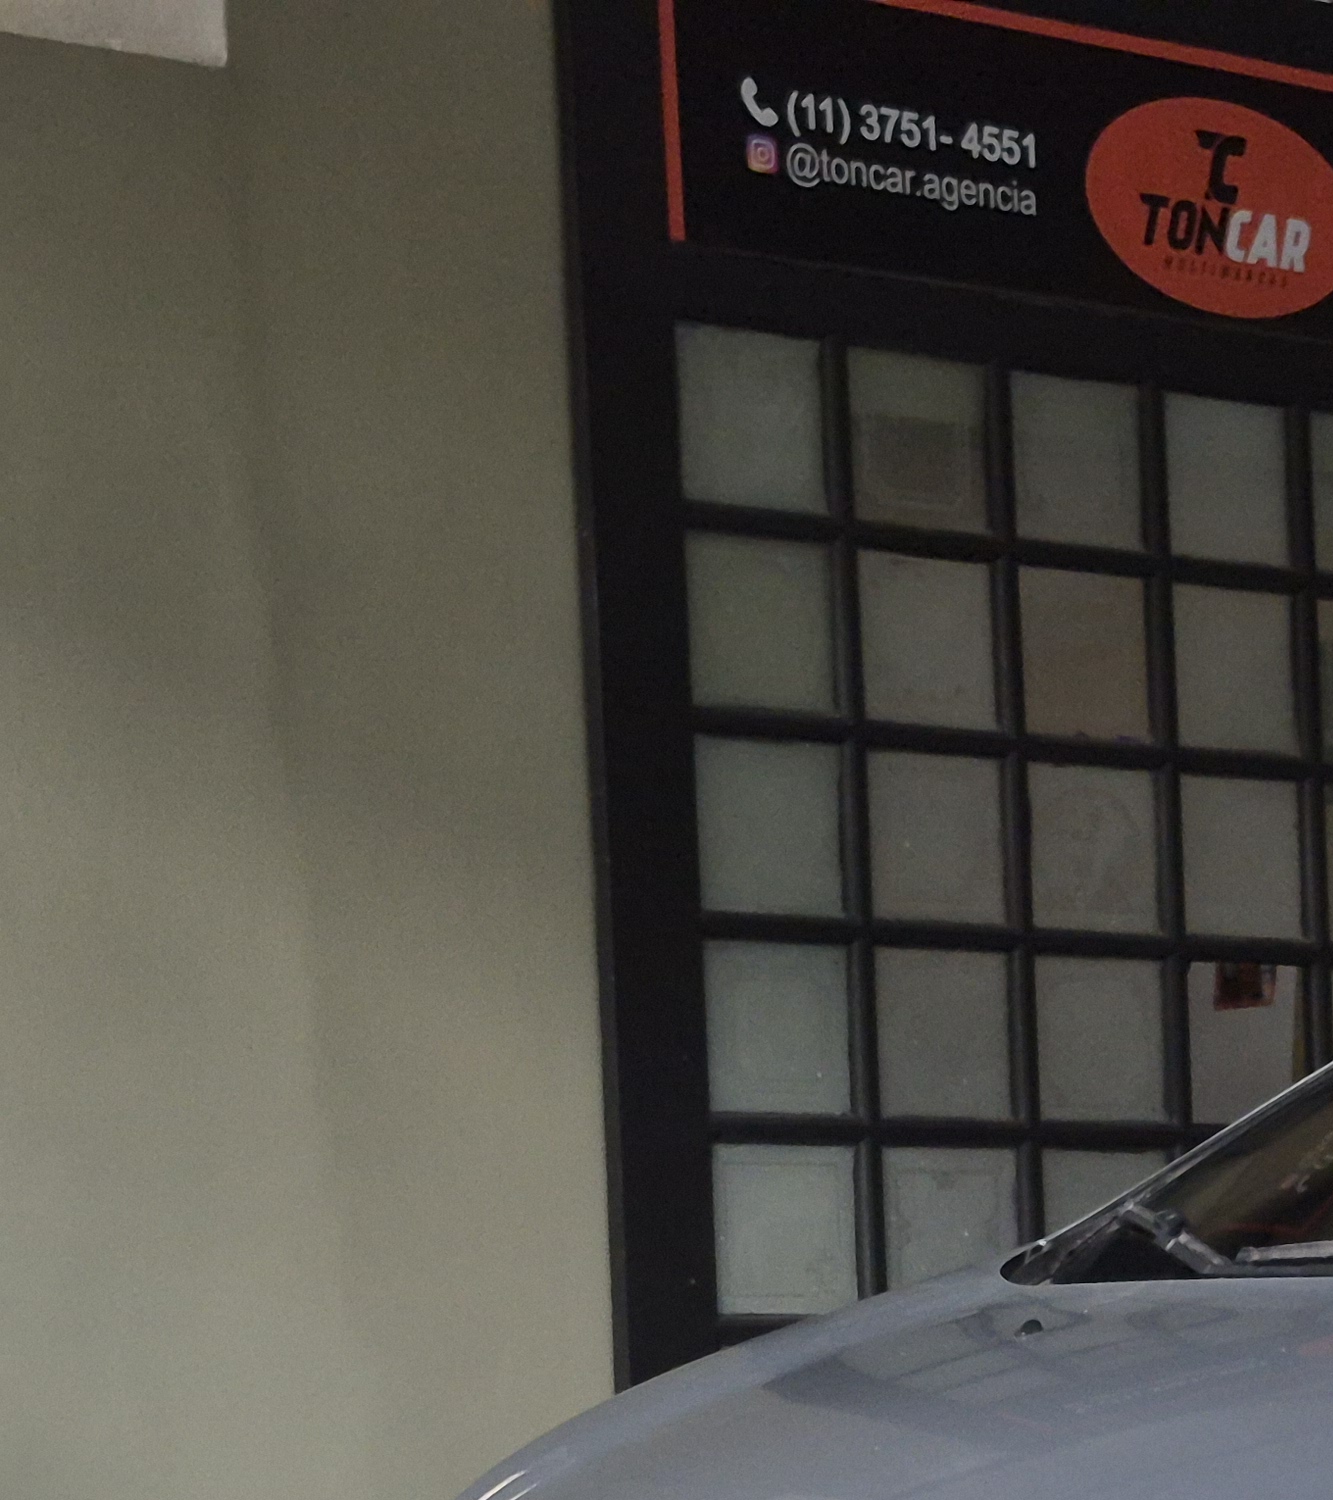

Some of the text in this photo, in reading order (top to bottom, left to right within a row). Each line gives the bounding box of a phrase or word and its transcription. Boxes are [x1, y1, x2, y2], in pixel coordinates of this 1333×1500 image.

[787, 90, 852, 144] (11)
[786, 142, 1038, 216] @toncar.agencia
[1140, 192, 1312, 273] TONCAR
